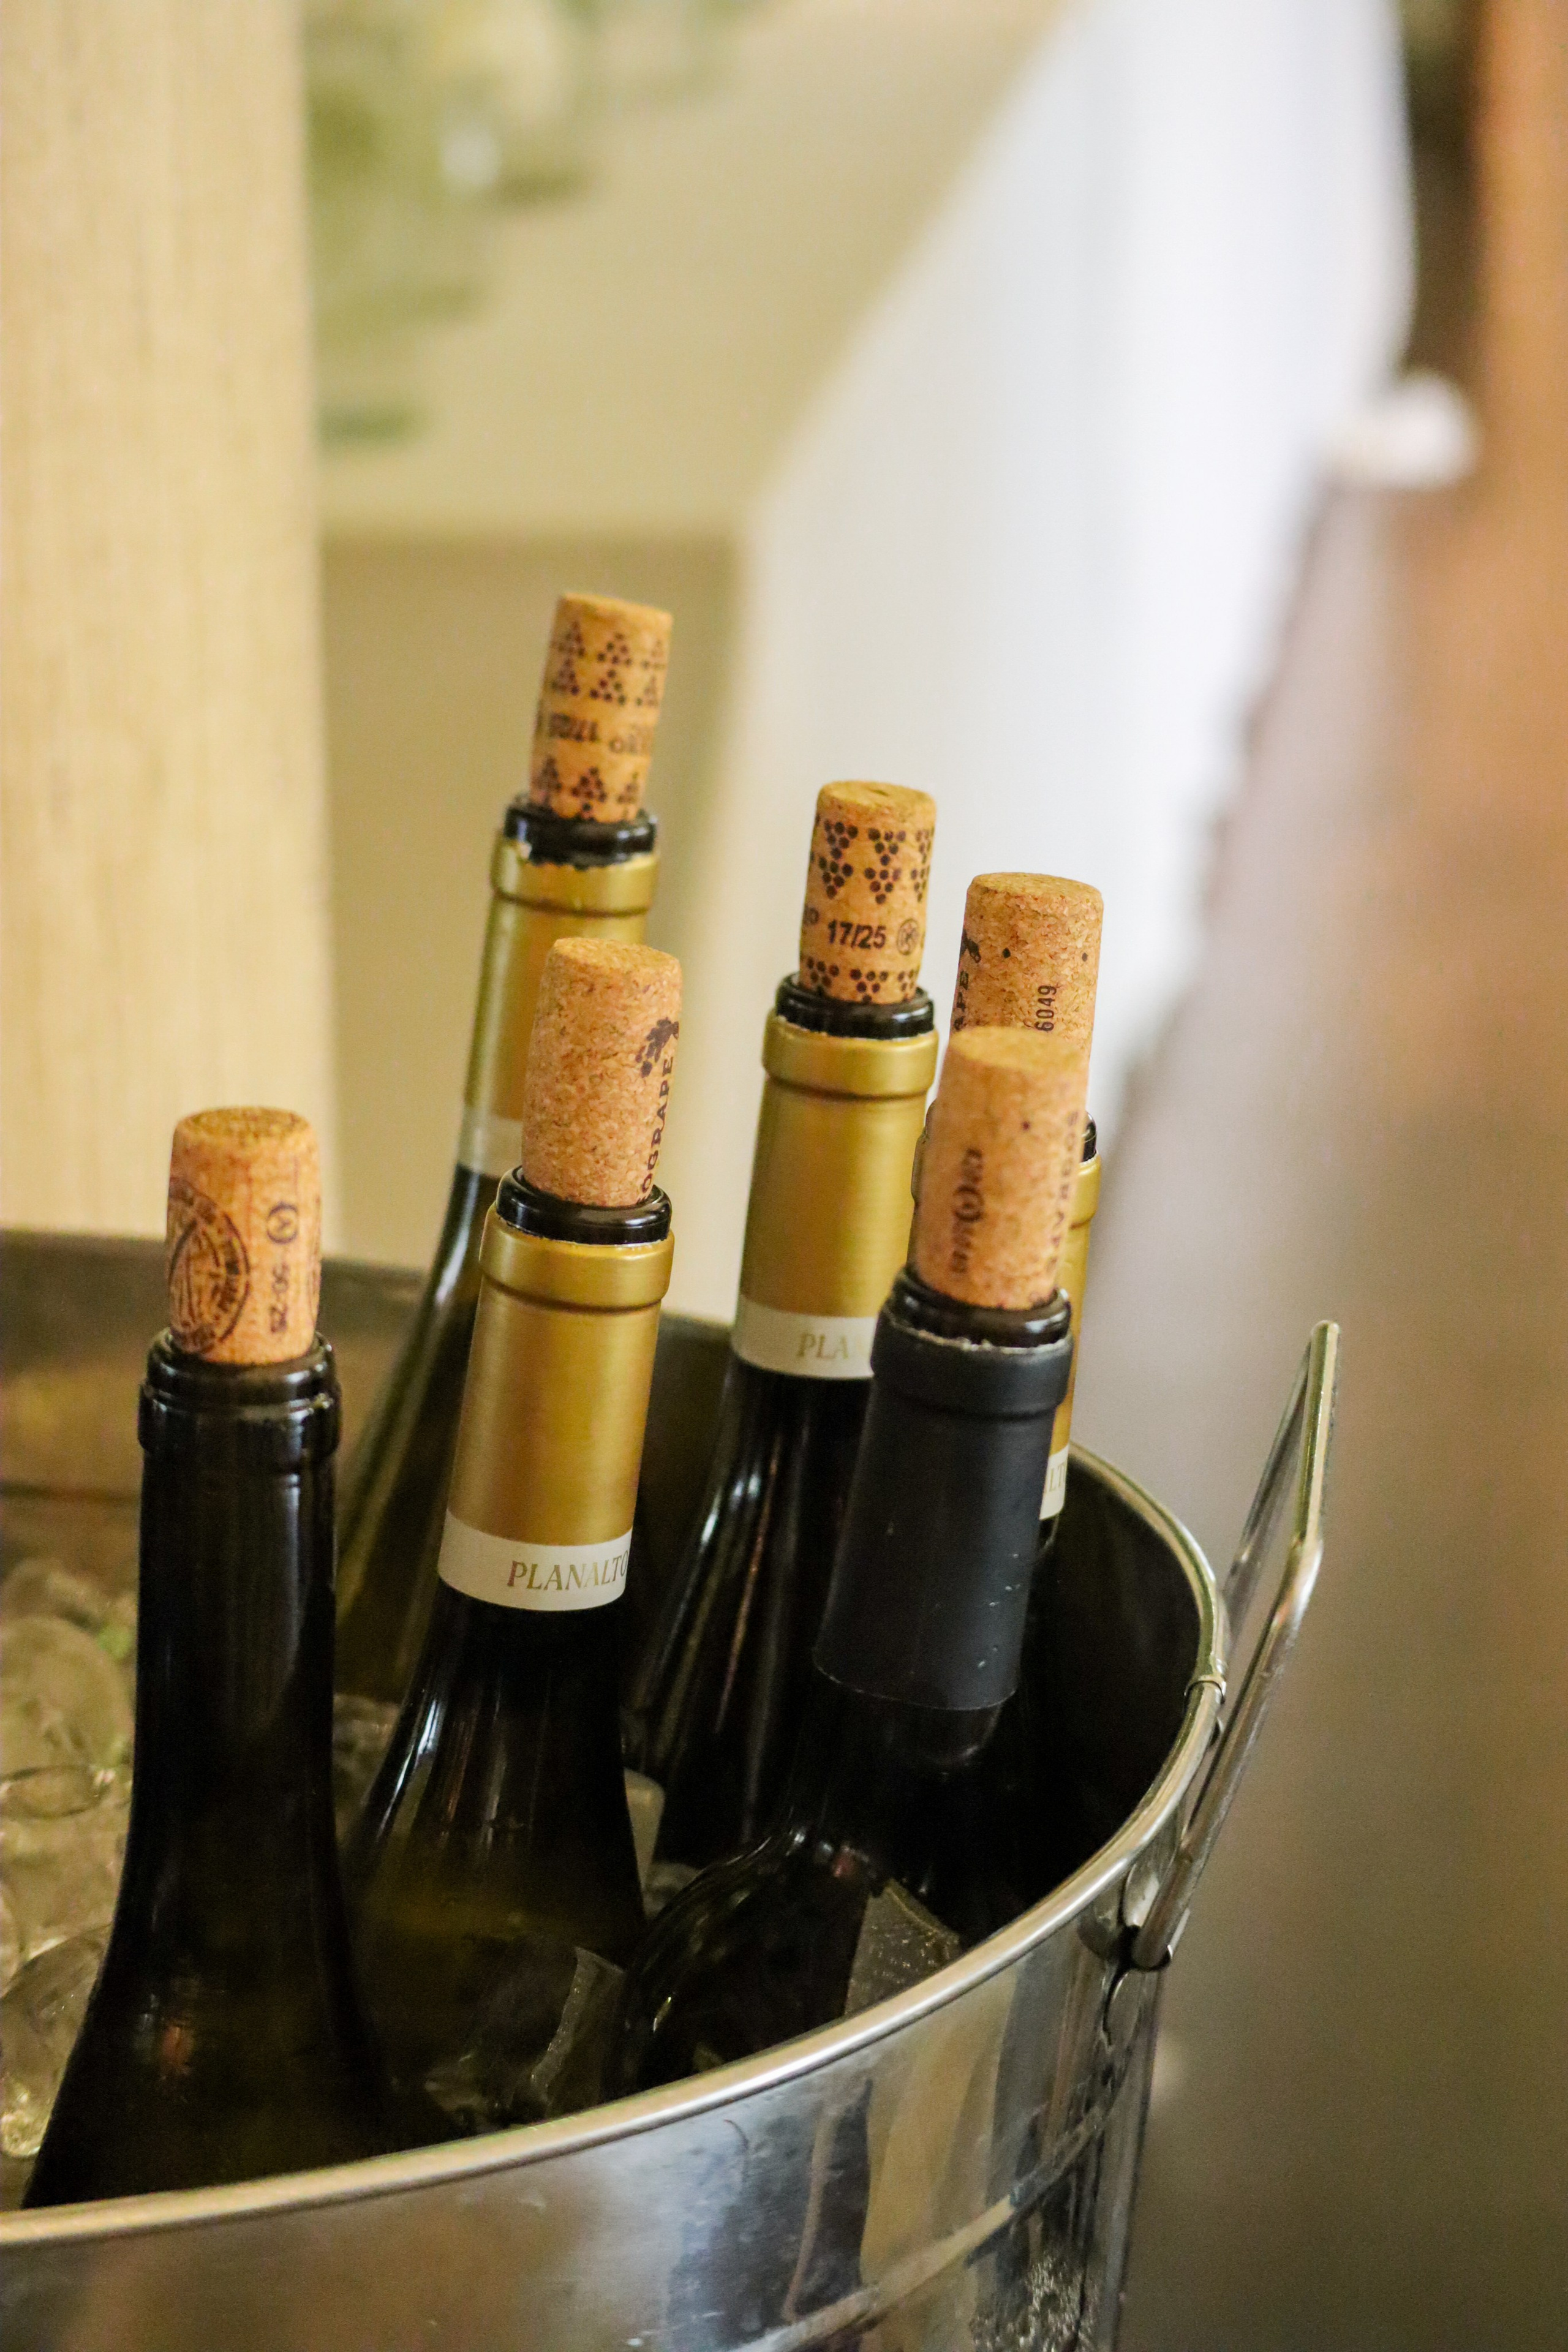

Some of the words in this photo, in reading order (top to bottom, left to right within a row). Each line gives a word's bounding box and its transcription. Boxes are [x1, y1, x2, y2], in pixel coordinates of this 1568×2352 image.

[828, 919, 886, 949] 17/25
[1035, 985, 1057, 1031] 6049
[797, 1332, 856, 1360] PLA
[507, 1550, 628, 1591] PLANALTO
